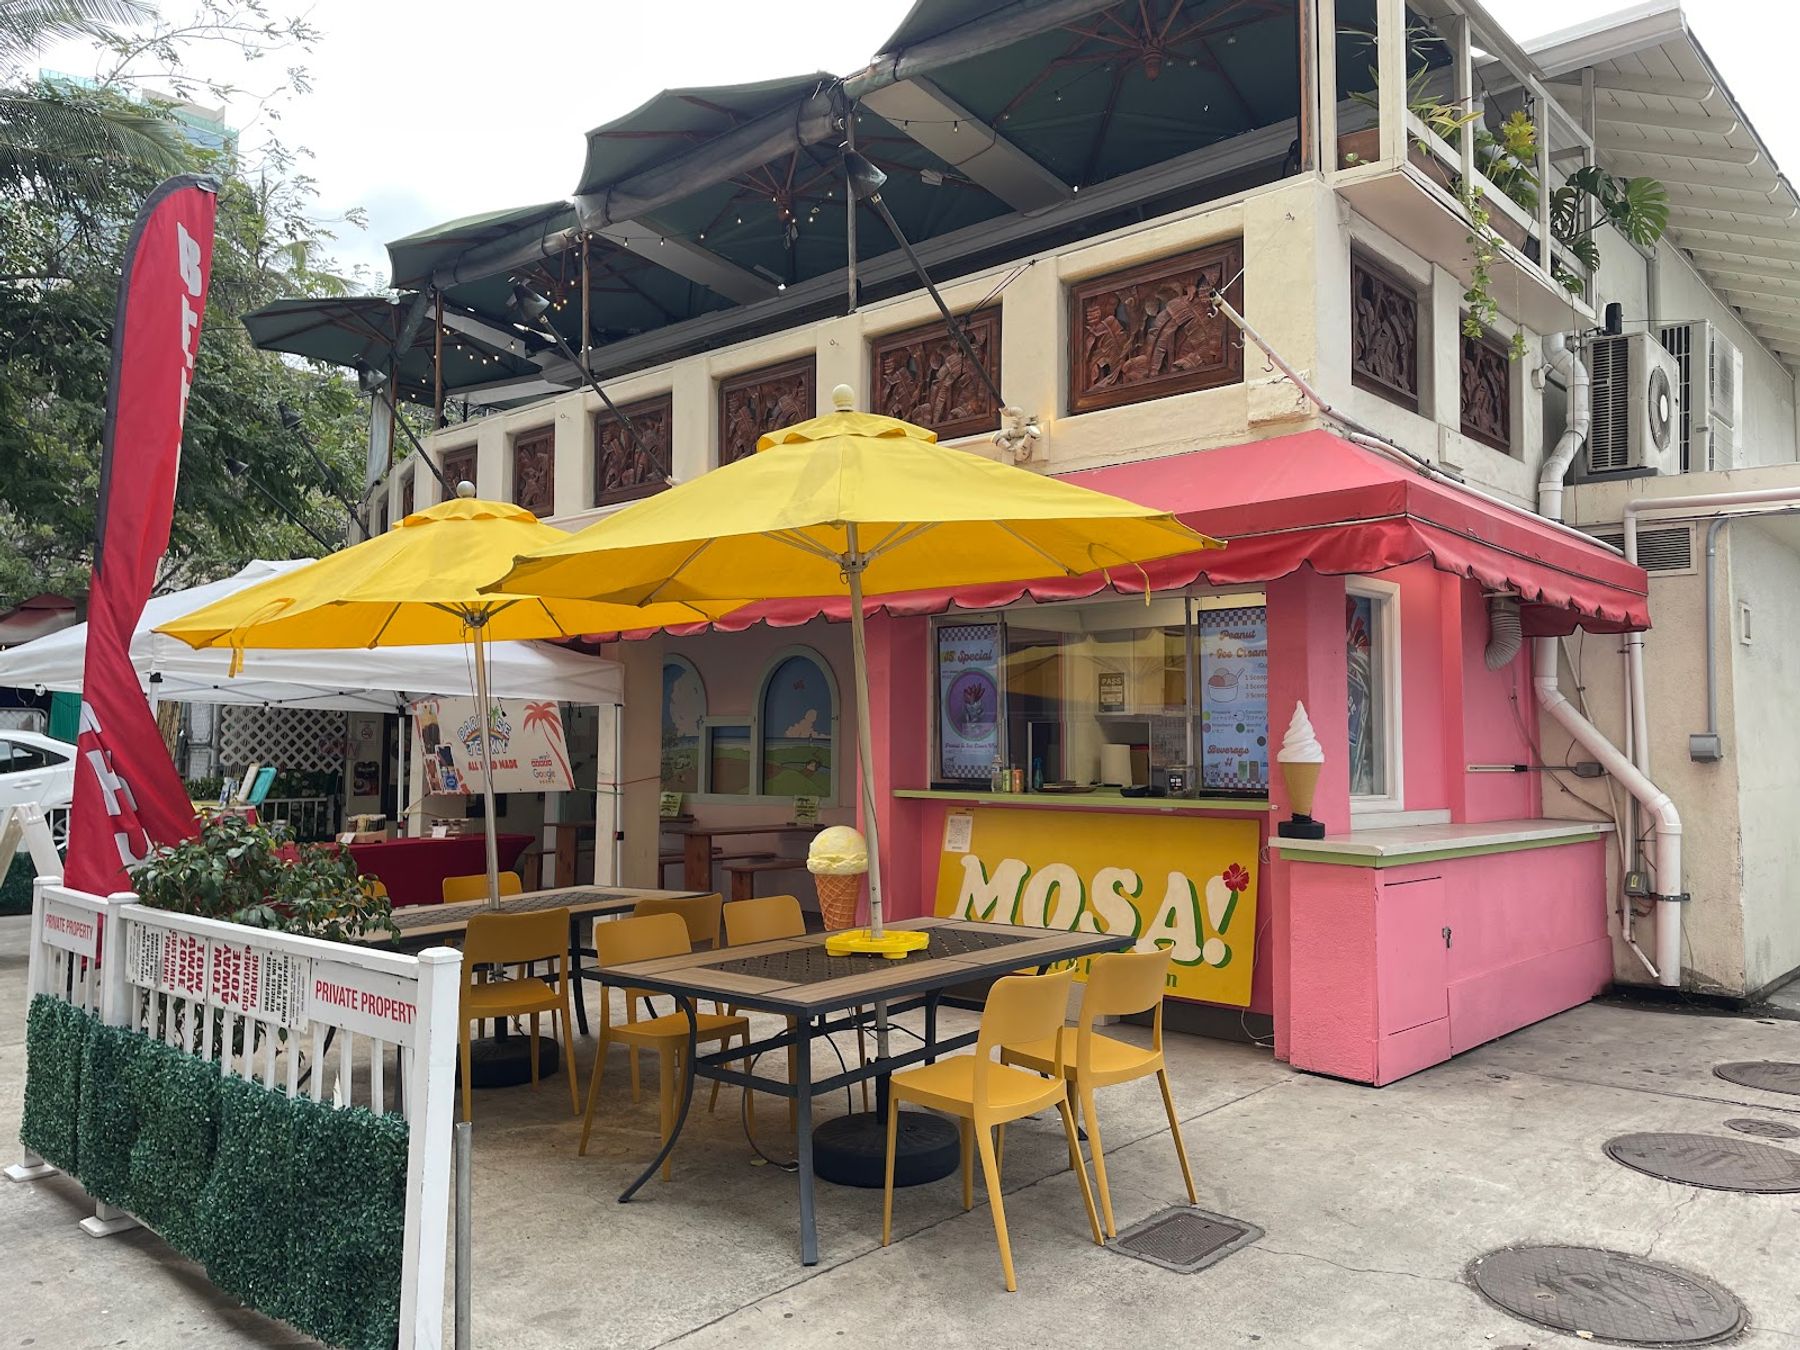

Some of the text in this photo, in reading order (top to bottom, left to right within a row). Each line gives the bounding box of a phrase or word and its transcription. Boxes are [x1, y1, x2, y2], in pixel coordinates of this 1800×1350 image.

[957, 649, 993, 664] Special
[466, 739, 510, 756] JEKY
[468, 761, 479, 771] ALL
[45, 913, 93, 941] PRIVATE PROPERTY
[949, 854, 1235, 968] MOSA!
[163, 935, 171, 983] PARKING
[169, 931, 178, 991] CUSTOMER
[178, 938, 187, 988] ZONE
[186, 936, 196, 995] AWAY
[195, 944, 205, 993] TOW
[212, 946, 222, 995] TOW
[221, 944, 232, 1005] AWAY
[230, 950, 241, 1004] ZONE
[242, 945, 251, 1012] CUSTOMER
[250, 955, 259, 1008] PARKING
[315, 980, 358, 1010] PRIVATE
